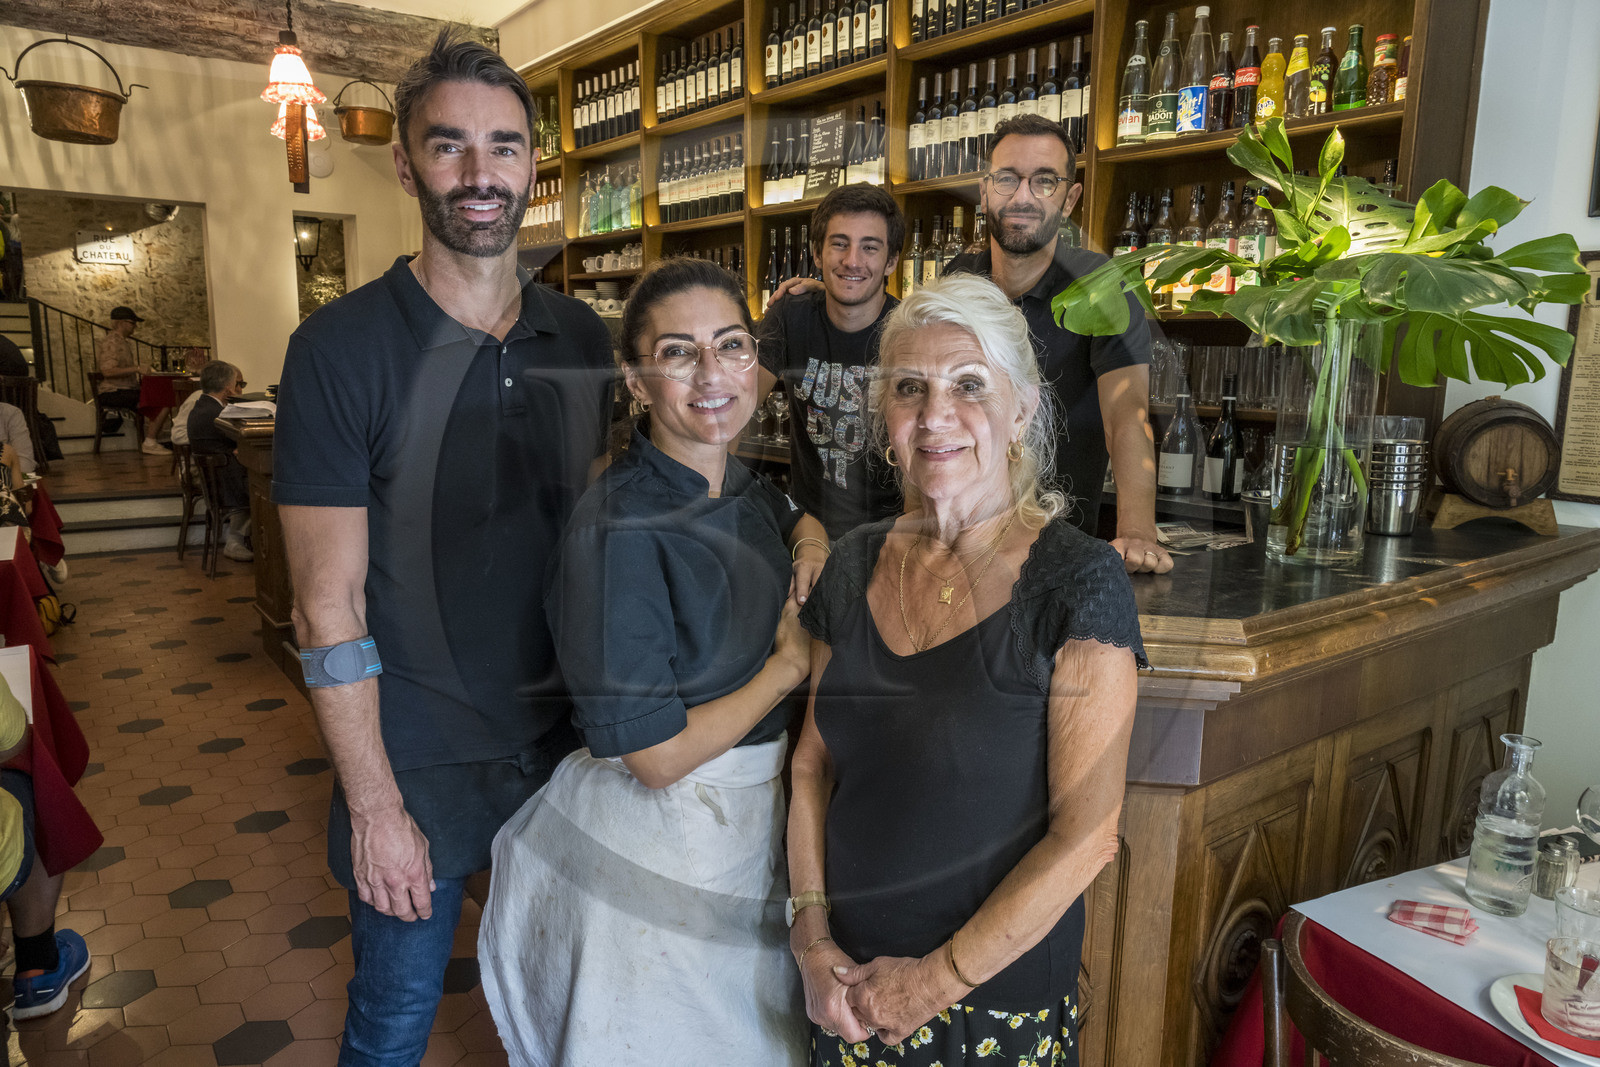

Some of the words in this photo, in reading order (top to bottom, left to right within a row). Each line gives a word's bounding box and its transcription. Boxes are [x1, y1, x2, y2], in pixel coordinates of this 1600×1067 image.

[1118, 115, 1140, 126] evian
[93, 234, 115, 243] RUE
[82, 250, 129, 260] CHATEAU
[794, 357, 880, 412] JUST
[806, 405, 866, 453] DO
[818, 448, 854, 490] IT
